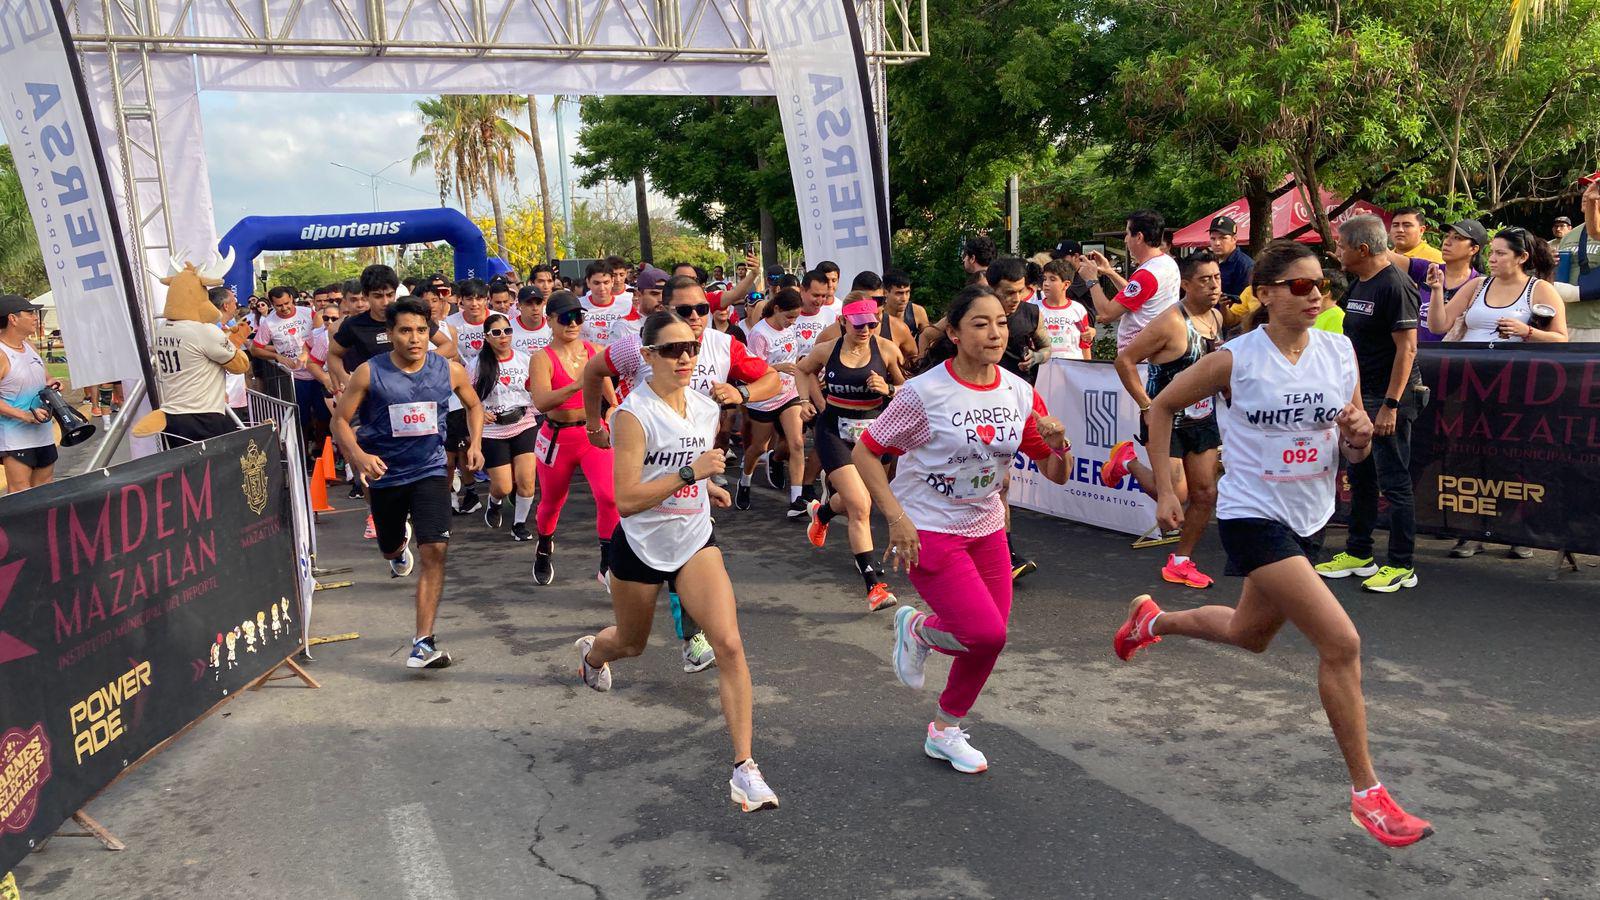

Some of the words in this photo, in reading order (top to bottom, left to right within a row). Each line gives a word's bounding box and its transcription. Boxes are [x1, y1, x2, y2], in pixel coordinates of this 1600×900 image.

[301, 221, 400, 241] dportenis
[158, 350, 181, 373] 911
[1283, 393, 1324, 405] TEAM
[404, 414, 426, 424] 096
[952, 407, 1021, 427] CARRERA
[1246, 408, 1304, 425] WHITE
[679, 437, 706, 448] TEAM
[644, 451, 693, 467] WHITE
[1282, 448, 1318, 464] 092
[1438, 474, 1545, 503] POWER
[1438, 493, 1497, 516] ADE
[47, 459, 213, 584] IMDEM
[53, 530, 216, 644] MAZATLÁN
[70, 660, 151, 735] POWER
[74, 708, 124, 765] ADE
